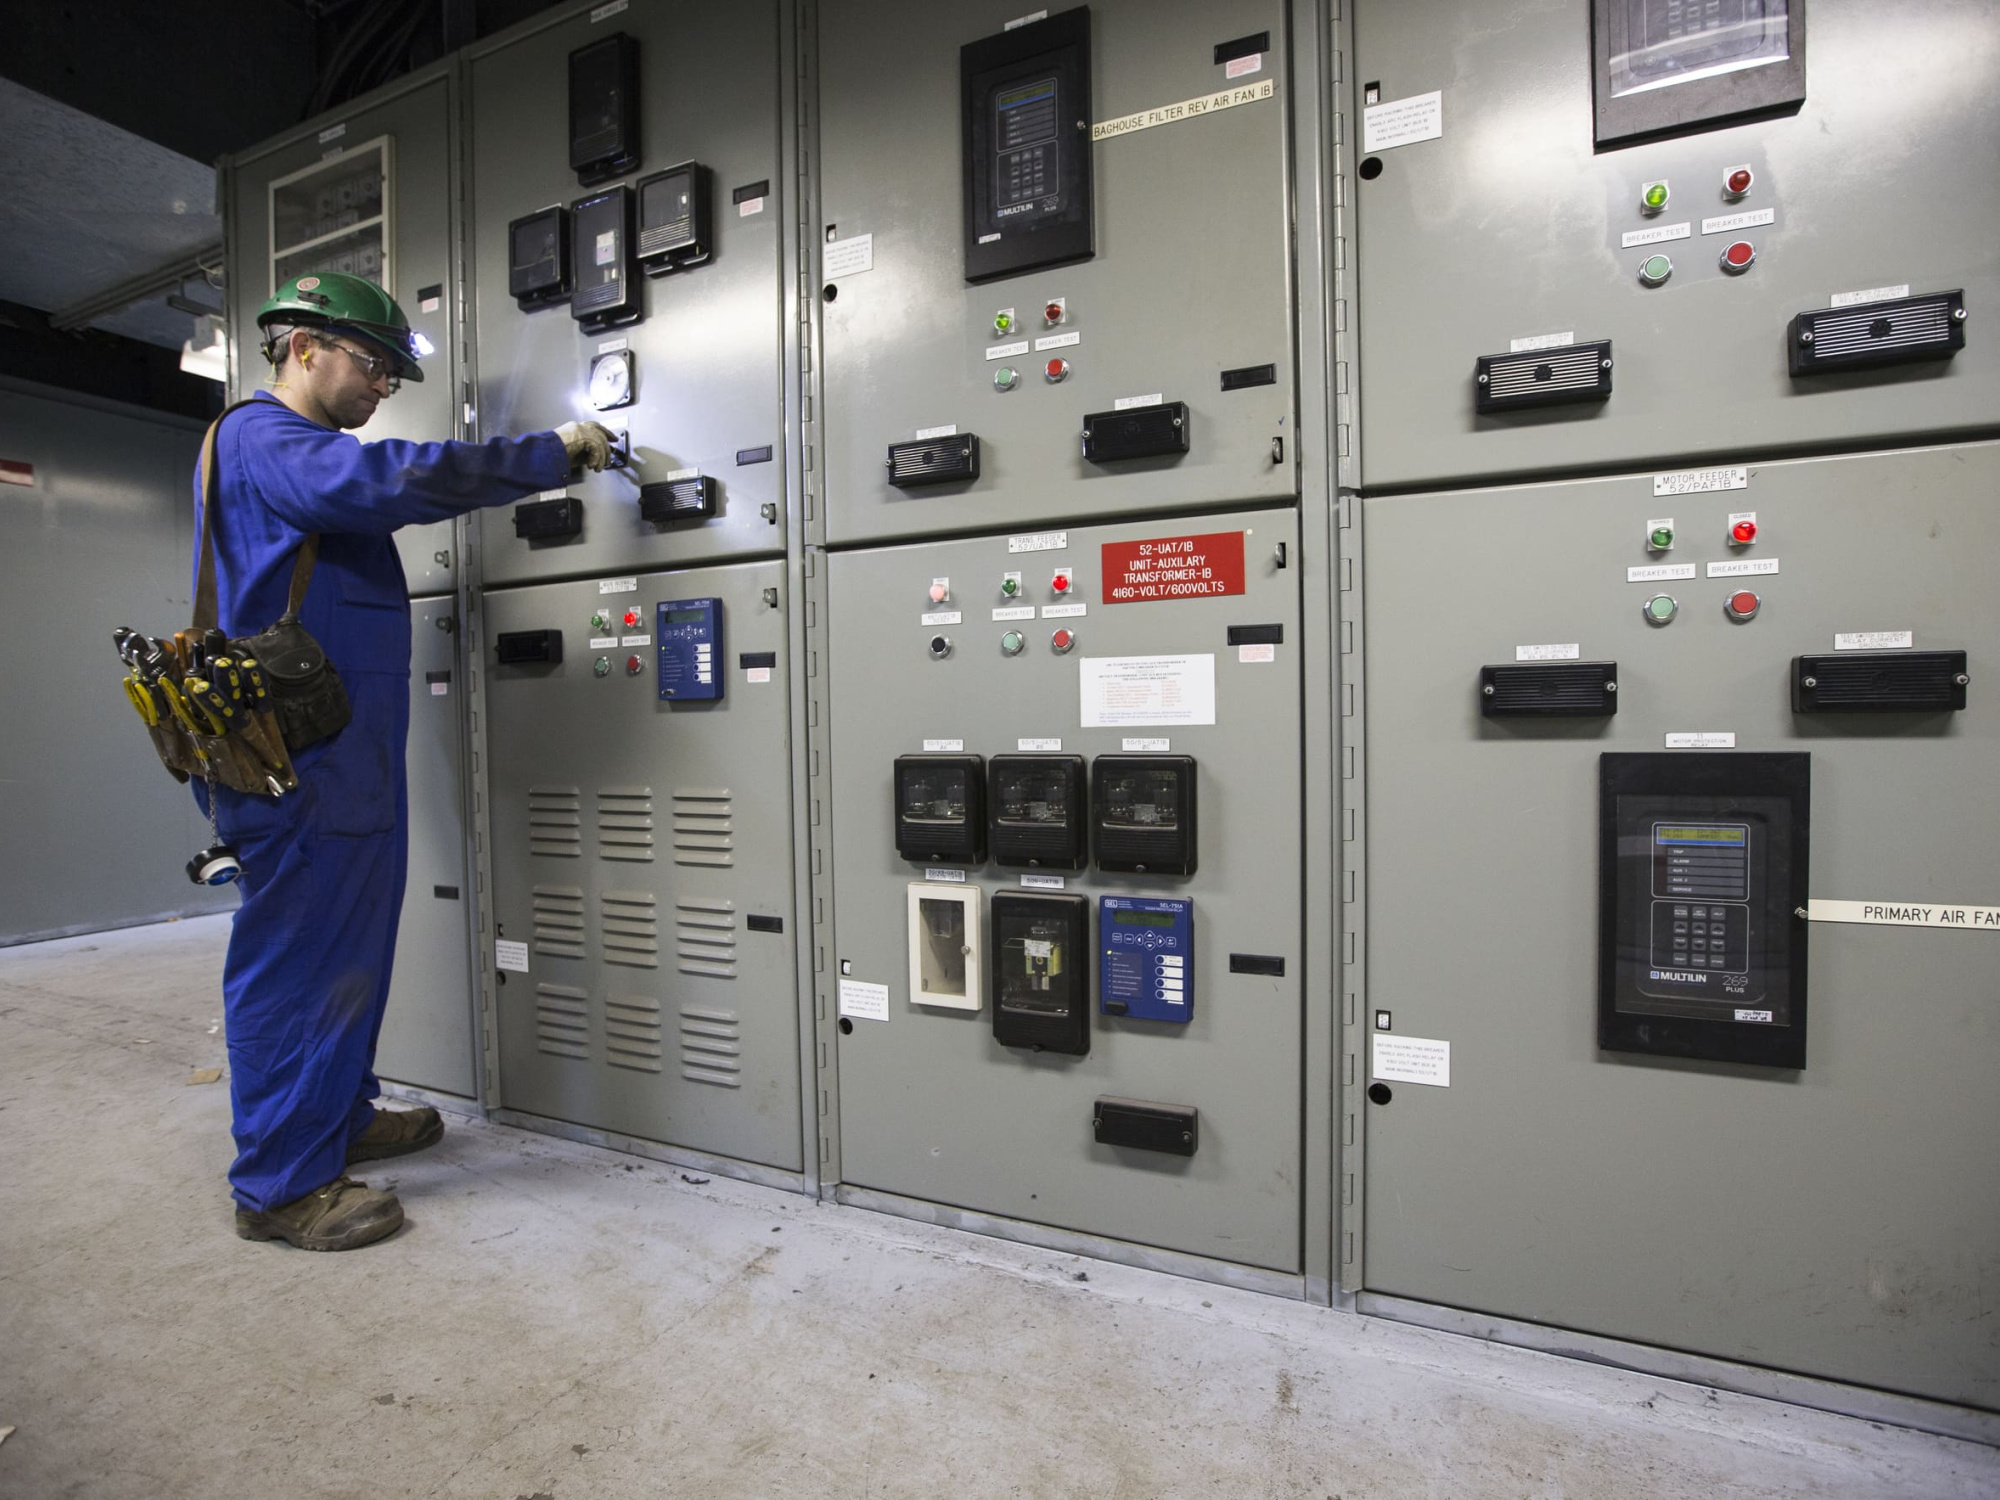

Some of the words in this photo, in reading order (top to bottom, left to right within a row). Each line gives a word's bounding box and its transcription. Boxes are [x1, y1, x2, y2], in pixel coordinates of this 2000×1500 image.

[1094, 115, 1144, 138] BAGHOUSE
[1149, 106, 1183, 124] FILTER
[1188, 100, 1209, 115] REV
[1213, 94, 1230, 108] AIR
[1234, 88, 1255, 103] FAN
[1043, 196, 1059, 208] 269
[1003, 203, 1034, 216] MULTILIN
[1707, 218, 1743, 229] BREAKER
[1749, 213, 1769, 222] TEST
[1626, 232, 1662, 243] BREAKER
[1666, 227, 1686, 237] TEST
[1663, 473, 1694, 485] MOTOR
[1700, 470, 1737, 480] FEEDER
[1669, 481, 1731, 493] 52/PAF1B
[1129, 555, 1206, 571] UNIT-AUXILARY
[1712, 565, 1748, 573] BREAKER
[1864, 906, 1931, 922] PRIMARY
[1940, 910, 1965, 924] AIR
[1660, 972, 1706, 983] MULTILIN
[1722, 975, 1748, 987] 269
